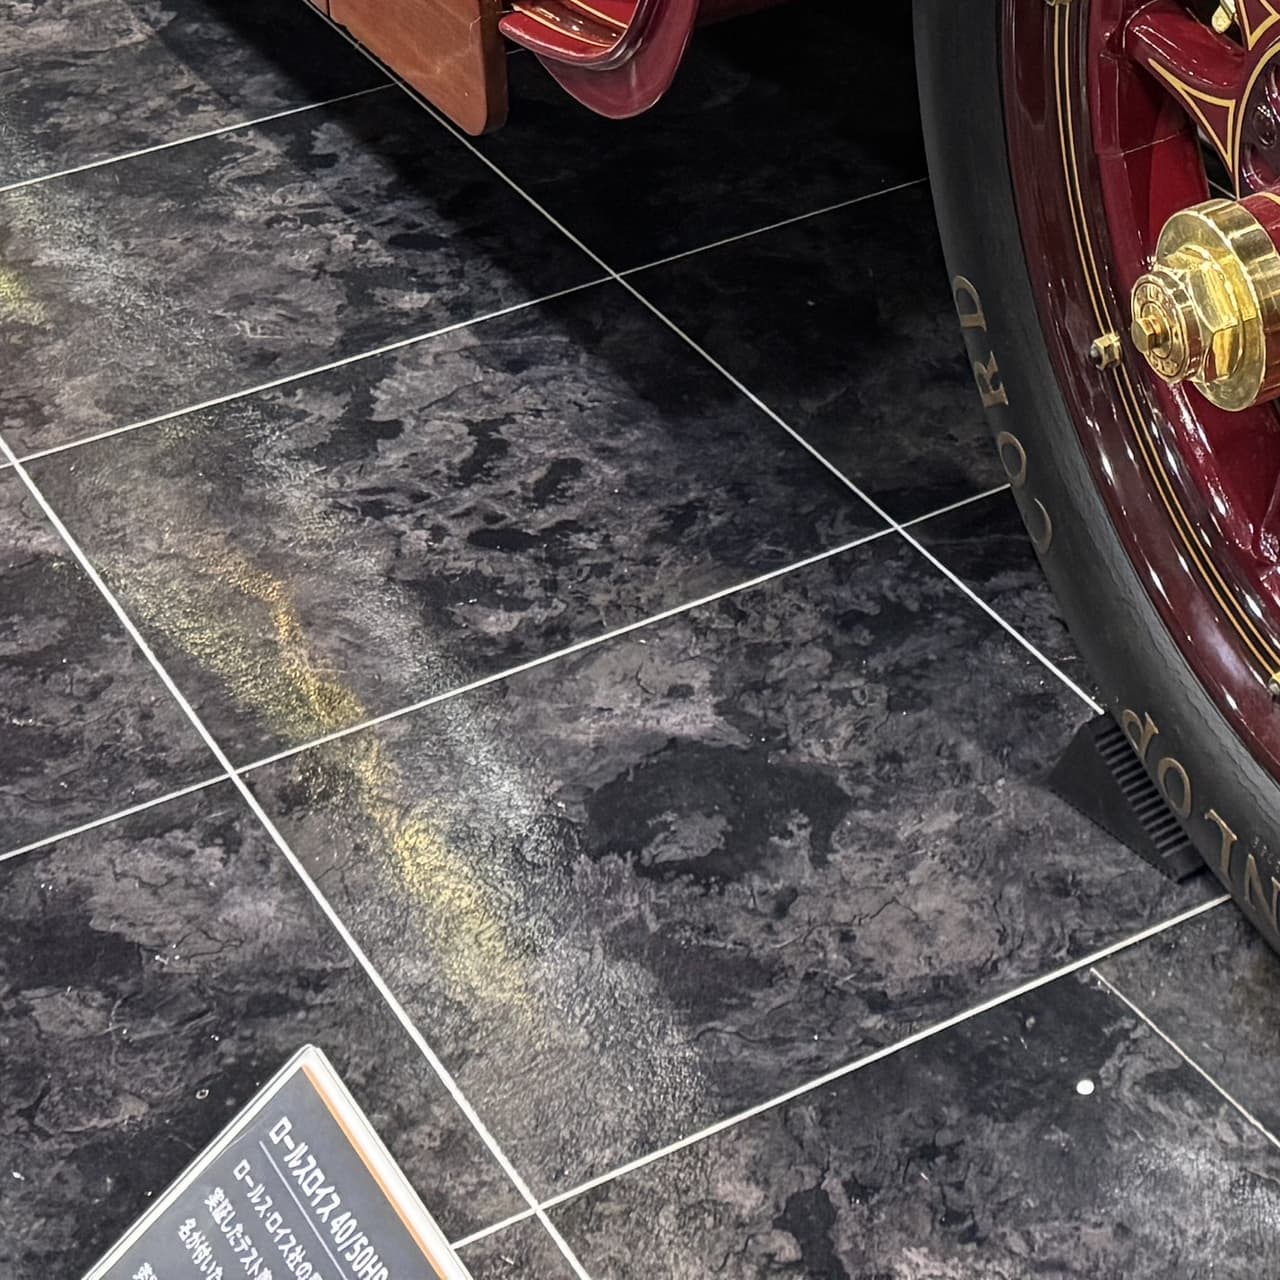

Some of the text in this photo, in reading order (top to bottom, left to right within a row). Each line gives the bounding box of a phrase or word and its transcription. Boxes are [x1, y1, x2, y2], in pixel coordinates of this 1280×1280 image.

[953, 273, 1054, 556] CORD
[233, 1159, 325, 1280] ロールス・ロイス社の
[269, 1116, 342, 1223] ロールスロイス
